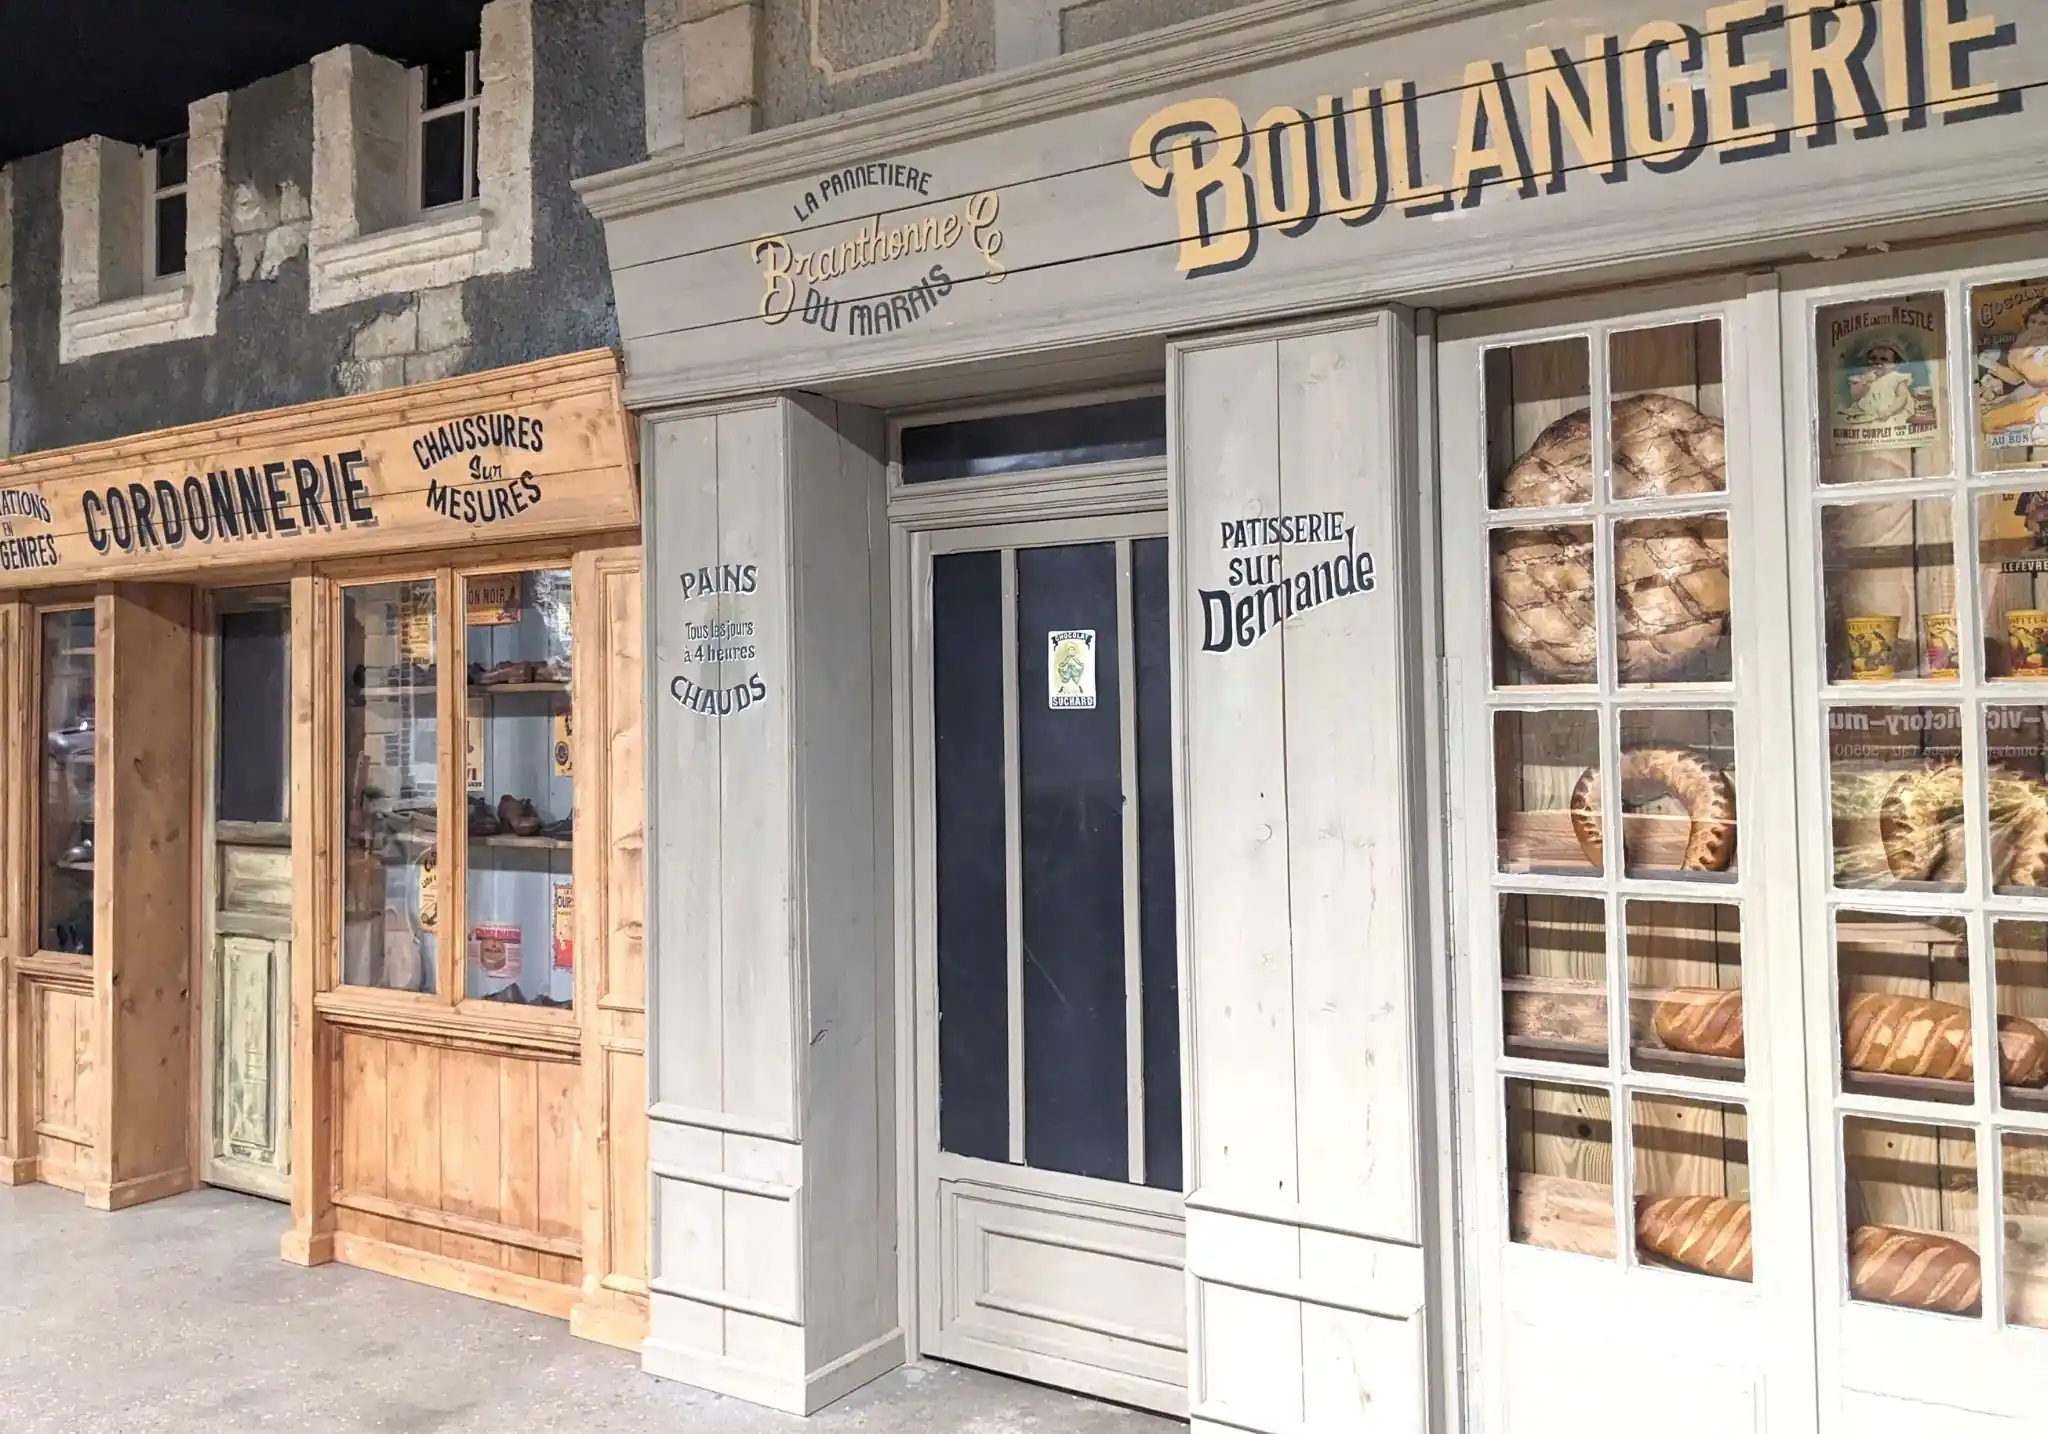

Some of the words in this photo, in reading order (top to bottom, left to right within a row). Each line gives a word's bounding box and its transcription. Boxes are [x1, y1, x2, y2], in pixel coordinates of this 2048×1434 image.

[793, 192, 819, 222] LA
[819, 163, 933, 202] PANNETIERE
[750, 213, 963, 325] Branthonne
[802, 287, 839, 332] DU
[849, 264, 952, 336] MARAIS
[1831, 313, 1869, 348] FARINE
[413, 413, 544, 470] CHAUSSURES
[469, 453, 502, 480] Sur
[81, 450, 379, 553] CORDONNERIE
[426, 469, 542, 524] MESURES
[1221, 511, 1344, 548] PATISSERIE
[0, 533, 58, 570] GENRES
[1228, 554, 1281, 586] sur
[680, 564, 757, 600] PAINS
[1198, 525, 1375, 652] Demande
[685, 622, 708, 640] Tous
[711, 619, 726, 637] les
[727, 620, 753, 640] jours
[684, 646, 692, 662] à
[694, 644, 704, 661] 4
[707, 644, 755, 662] heures
[670, 672, 766, 715] CHAUDS
[1052, 696, 1093, 706] SUCHARD
